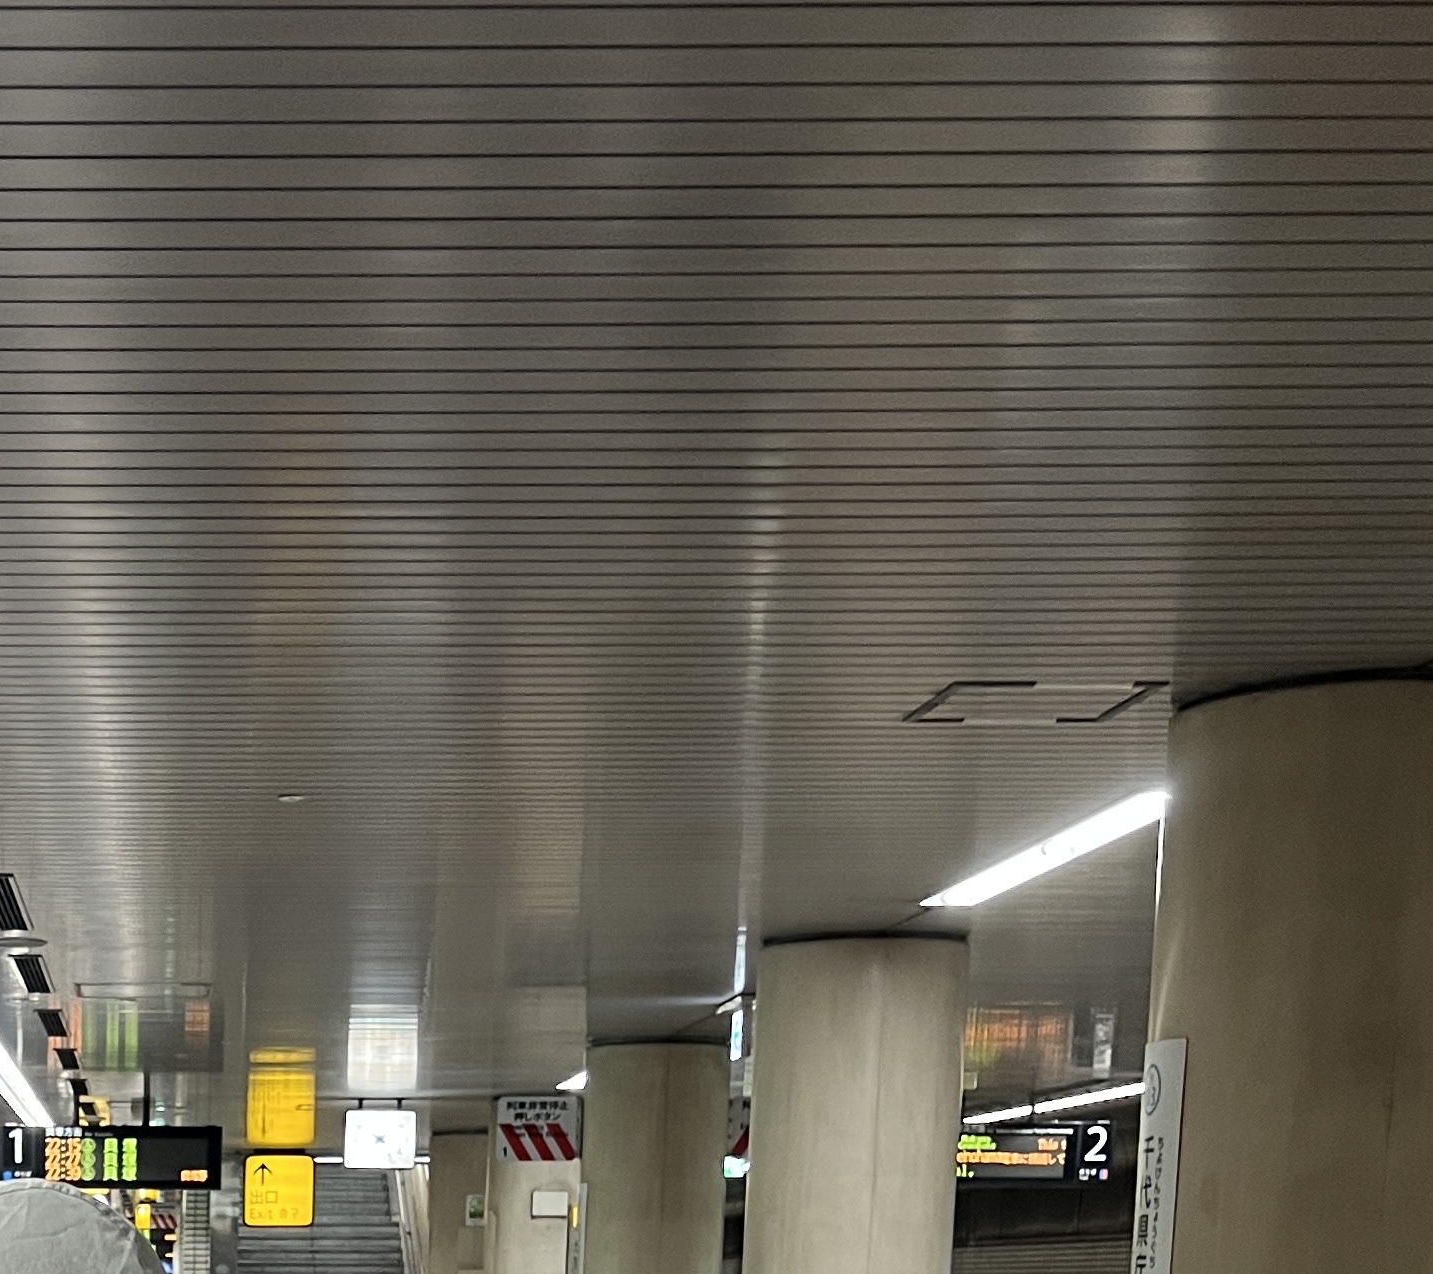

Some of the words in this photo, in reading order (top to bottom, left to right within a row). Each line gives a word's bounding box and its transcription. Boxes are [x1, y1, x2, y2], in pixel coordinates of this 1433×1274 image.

[8, 1128, 23, 1164] 1
[1084, 1125, 1108, 1162] 2
[250, 1190, 278, 1204] 出口
